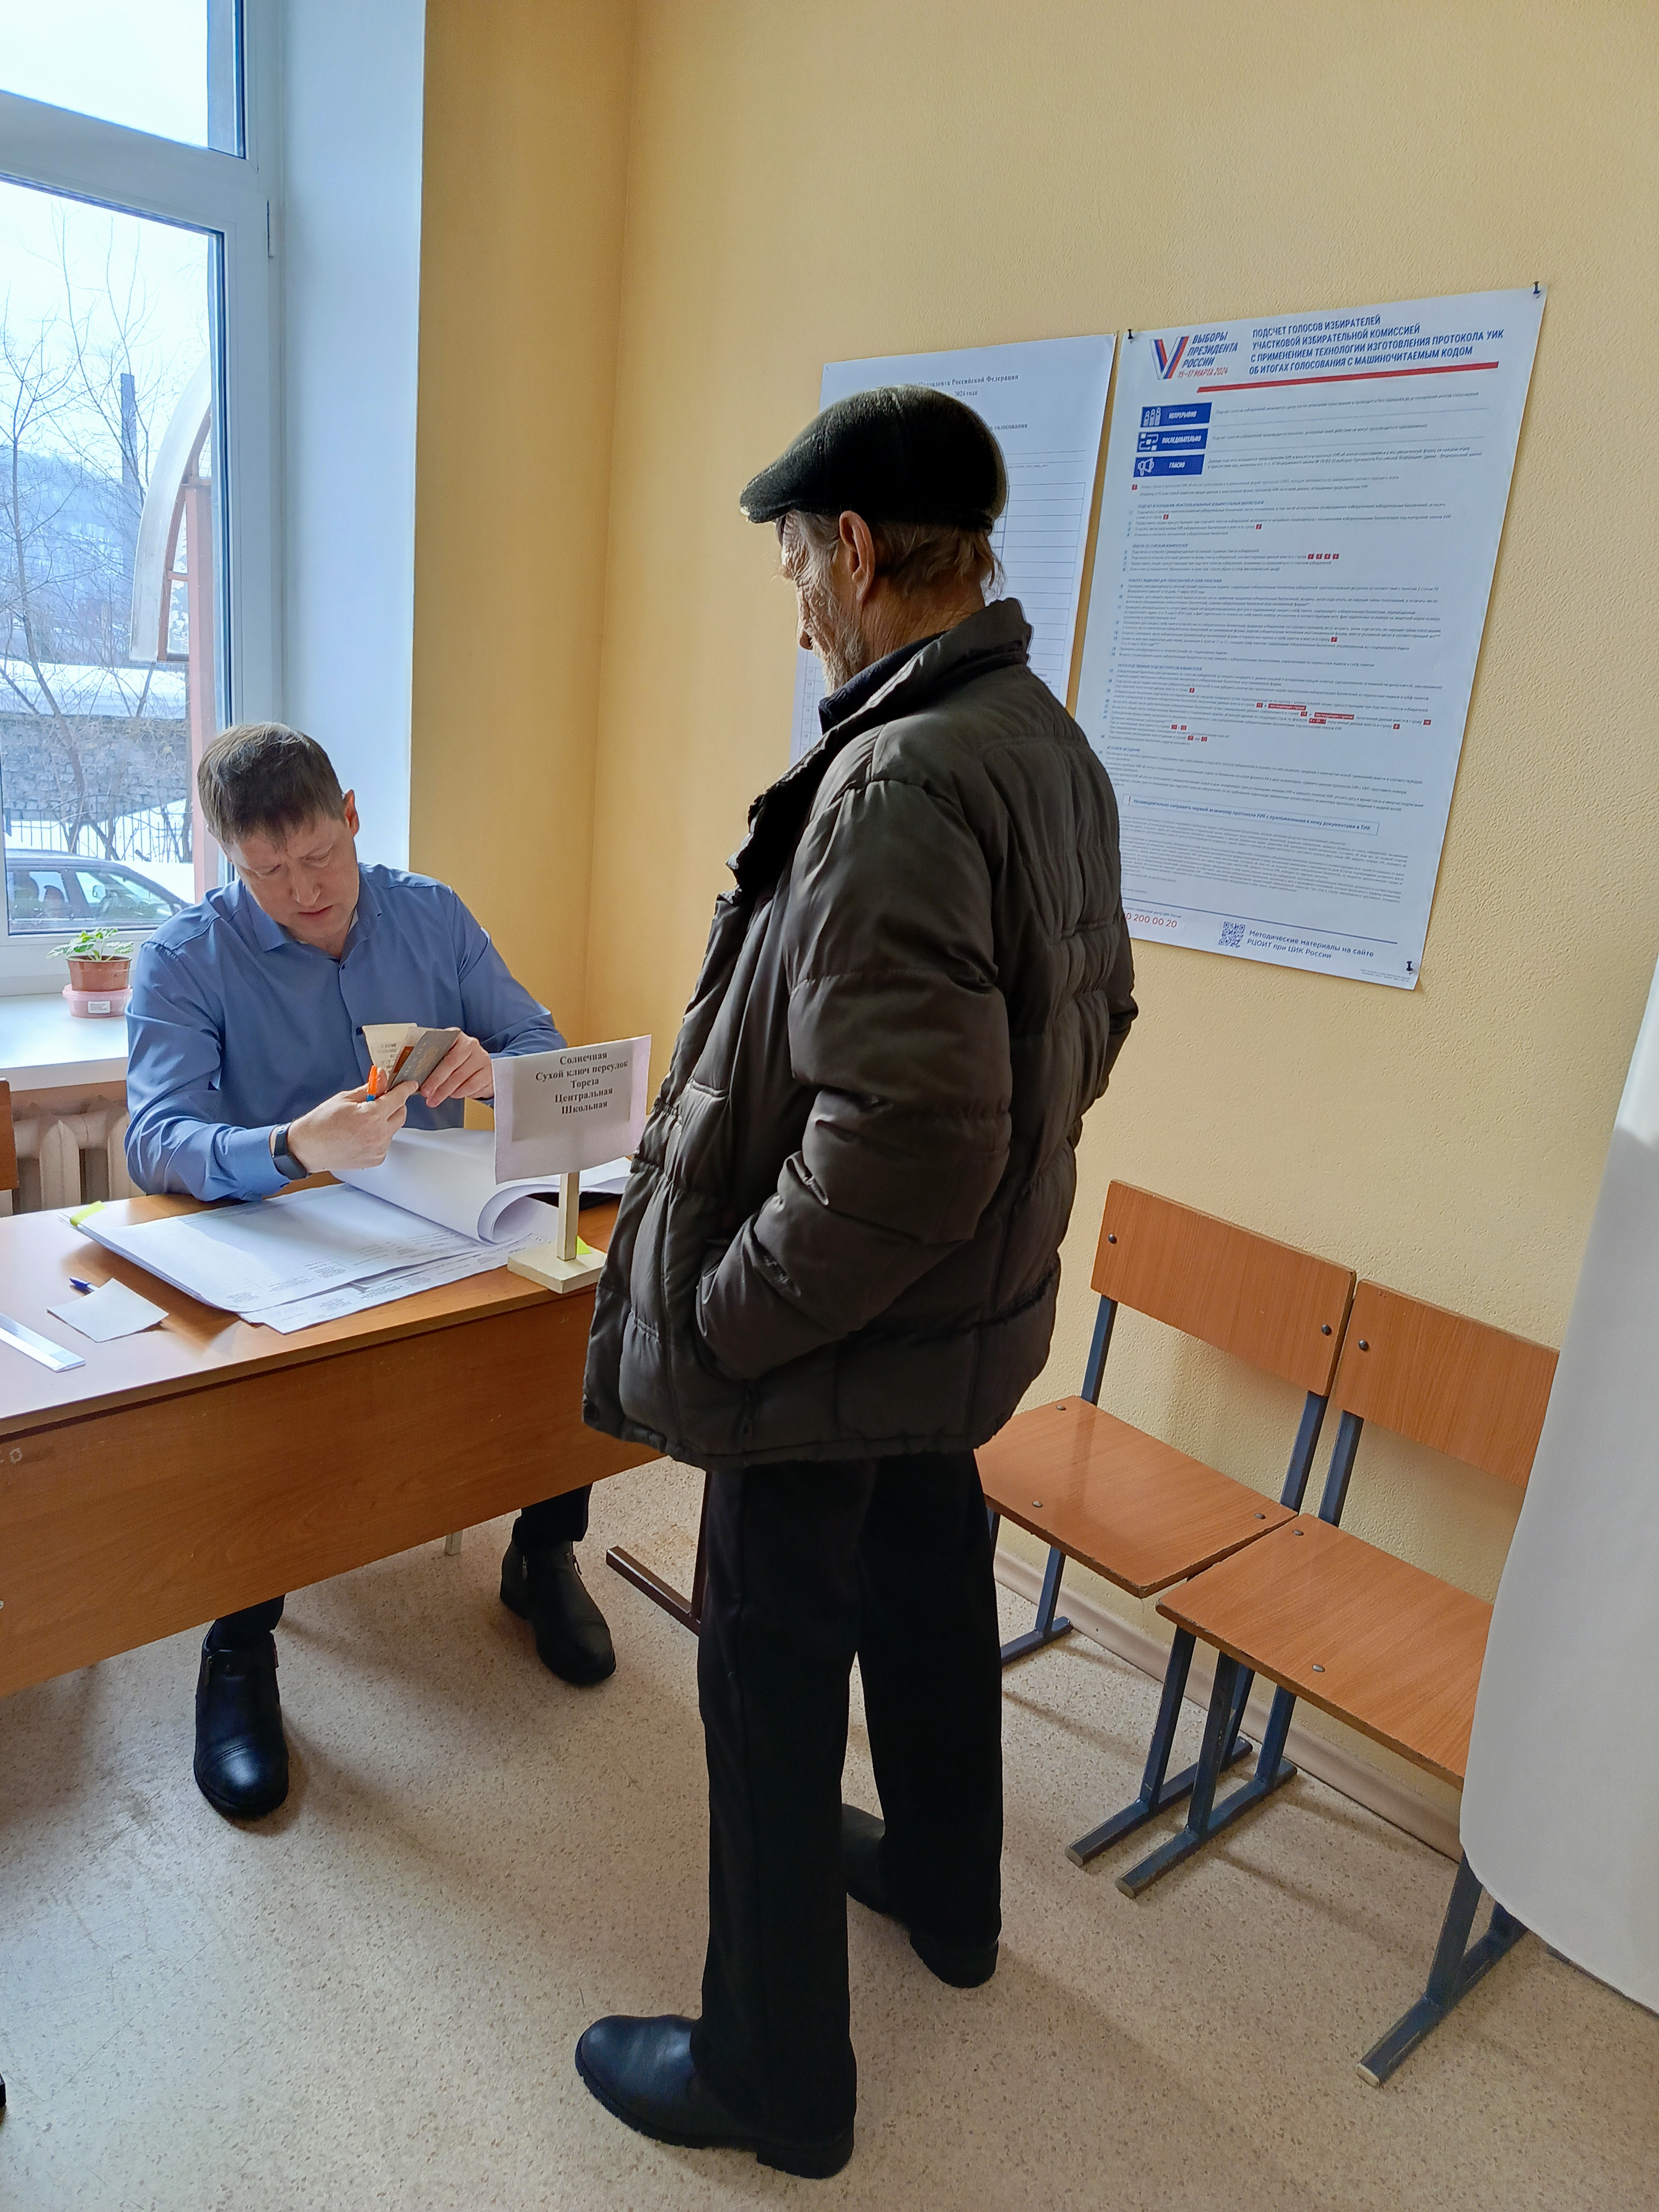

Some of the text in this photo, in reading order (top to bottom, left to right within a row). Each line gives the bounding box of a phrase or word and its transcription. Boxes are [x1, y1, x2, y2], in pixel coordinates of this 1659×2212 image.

[1253, 314, 1380, 339] ПОДСЧЕТ ГОЛОСОВ ИЗБИРАТЕЛЕЙ
[1192, 331, 1228, 345] ВЫБОРЫ
[1253, 323, 1420, 351] УЧАСТКОВОЙ ИЗБИРАТЕЛЬНОЙ КОМИССИЕЙ
[1187, 342, 1238, 357] ПРЕЗИДЕНТА
[1251, 329, 1504, 362] С ПРИМЕНЕНИЕМ ТЕХНОЛОГИИ ИЗГОТОВЛЕНИЯ ПРОТОКОЛА УИК
[1182, 356, 1215, 368] РОССИИ
[1249, 346, 1473, 375] ОБ ИТОГАХ ГОЛОСОВАНИЯ С МАШИНОЧИТАЕМЫМ КОДОМ
[1133, 914, 1150, 923] 200
[1152, 917, 1164, 926] 00
[1166, 919, 1177, 928] 20
[1247, 938, 1272, 948] РЦОИТ
[1288, 945, 1304, 954] ЦИК
[1306, 949, 1331, 959] России
[1249, 930, 1298, 944] Методические
[1301, 940, 1340, 951] материалы
[1353, 949, 1374, 957] сайте
[560, 1051, 608, 1065] Солнечная
[535, 1060, 628, 1082] Сухой ключ переулок
[571, 1079, 599, 1090] Тореза
[555, 1088, 613, 1104] Центральная
[561, 1100, 608, 1114] Школьная
